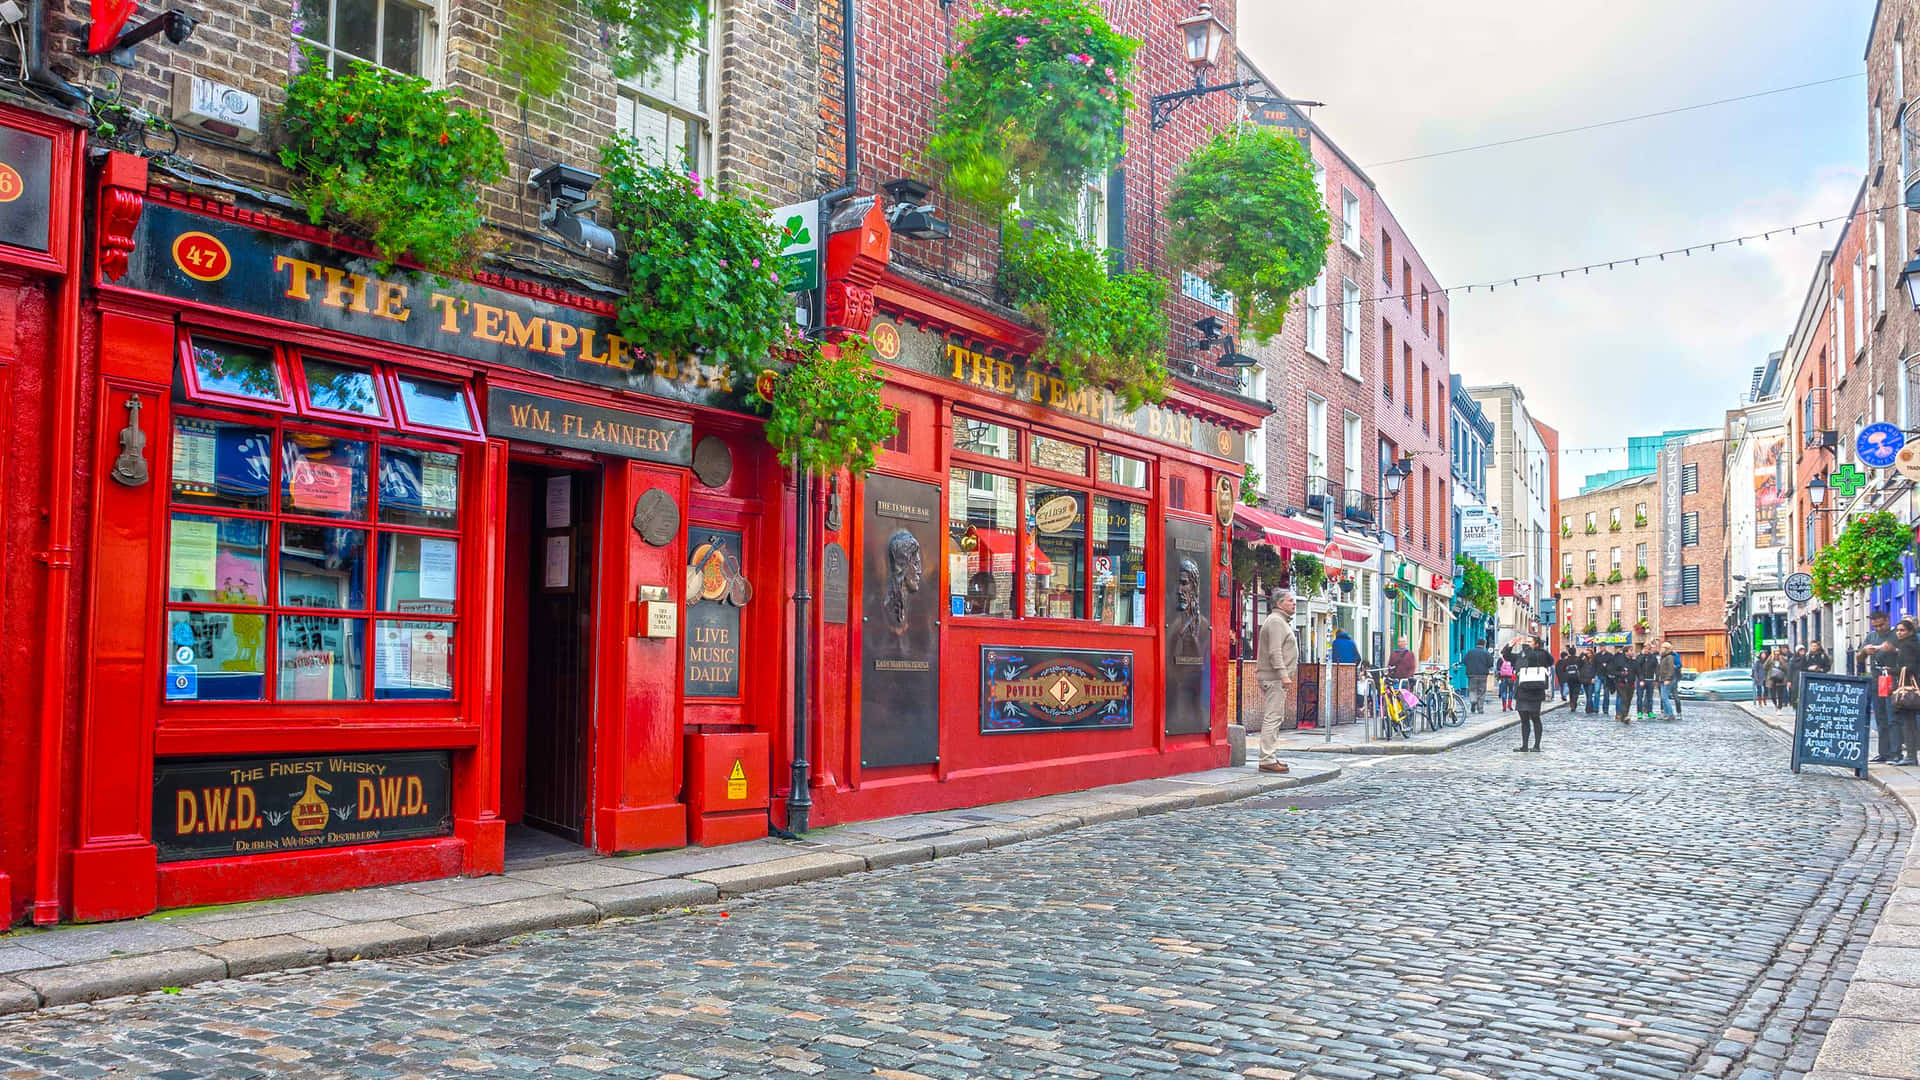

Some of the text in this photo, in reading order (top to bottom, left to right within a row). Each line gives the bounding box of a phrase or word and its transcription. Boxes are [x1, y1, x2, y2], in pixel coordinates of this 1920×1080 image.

[1263, 110, 1287, 121] THE
[0, 171, 12, 193] 6
[186, 244, 217, 269] 47
[273, 255, 410, 322] THE
[431, 293, 636, 370] TEMPLE
[878, 329, 895, 354] 48
[945, 343, 1016, 395] THE
[1148, 405, 1193, 450] BAR
[509, 402, 677, 452] WM. FLANNERY
[1666, 441, 1678, 525] ENROLLING
[1667, 530, 1677, 566] NOW
[695, 627, 729, 644] LIVE
[689, 647, 734, 664] MUSIC
[690, 665, 732, 682] DAILY
[1006, 683, 1121, 698] POWERS WHISKEY
[1060, 679, 1070, 702] P
[1808, 682, 1834, 694] Mexico
[1816, 693, 1859, 704] Lunch Deal
[1806, 703, 1833, 713] Starter
[1840, 705, 1859, 715] Main
[1842, 731, 1859, 741] Deal
[230, 757, 387, 785] THE FINEST WHISKY
[357, 774, 428, 820] D.W.D.
[176, 785, 263, 835] D.W.D.
[235, 829, 380, 852] DUBLIN WHISKY DISTILLERY
